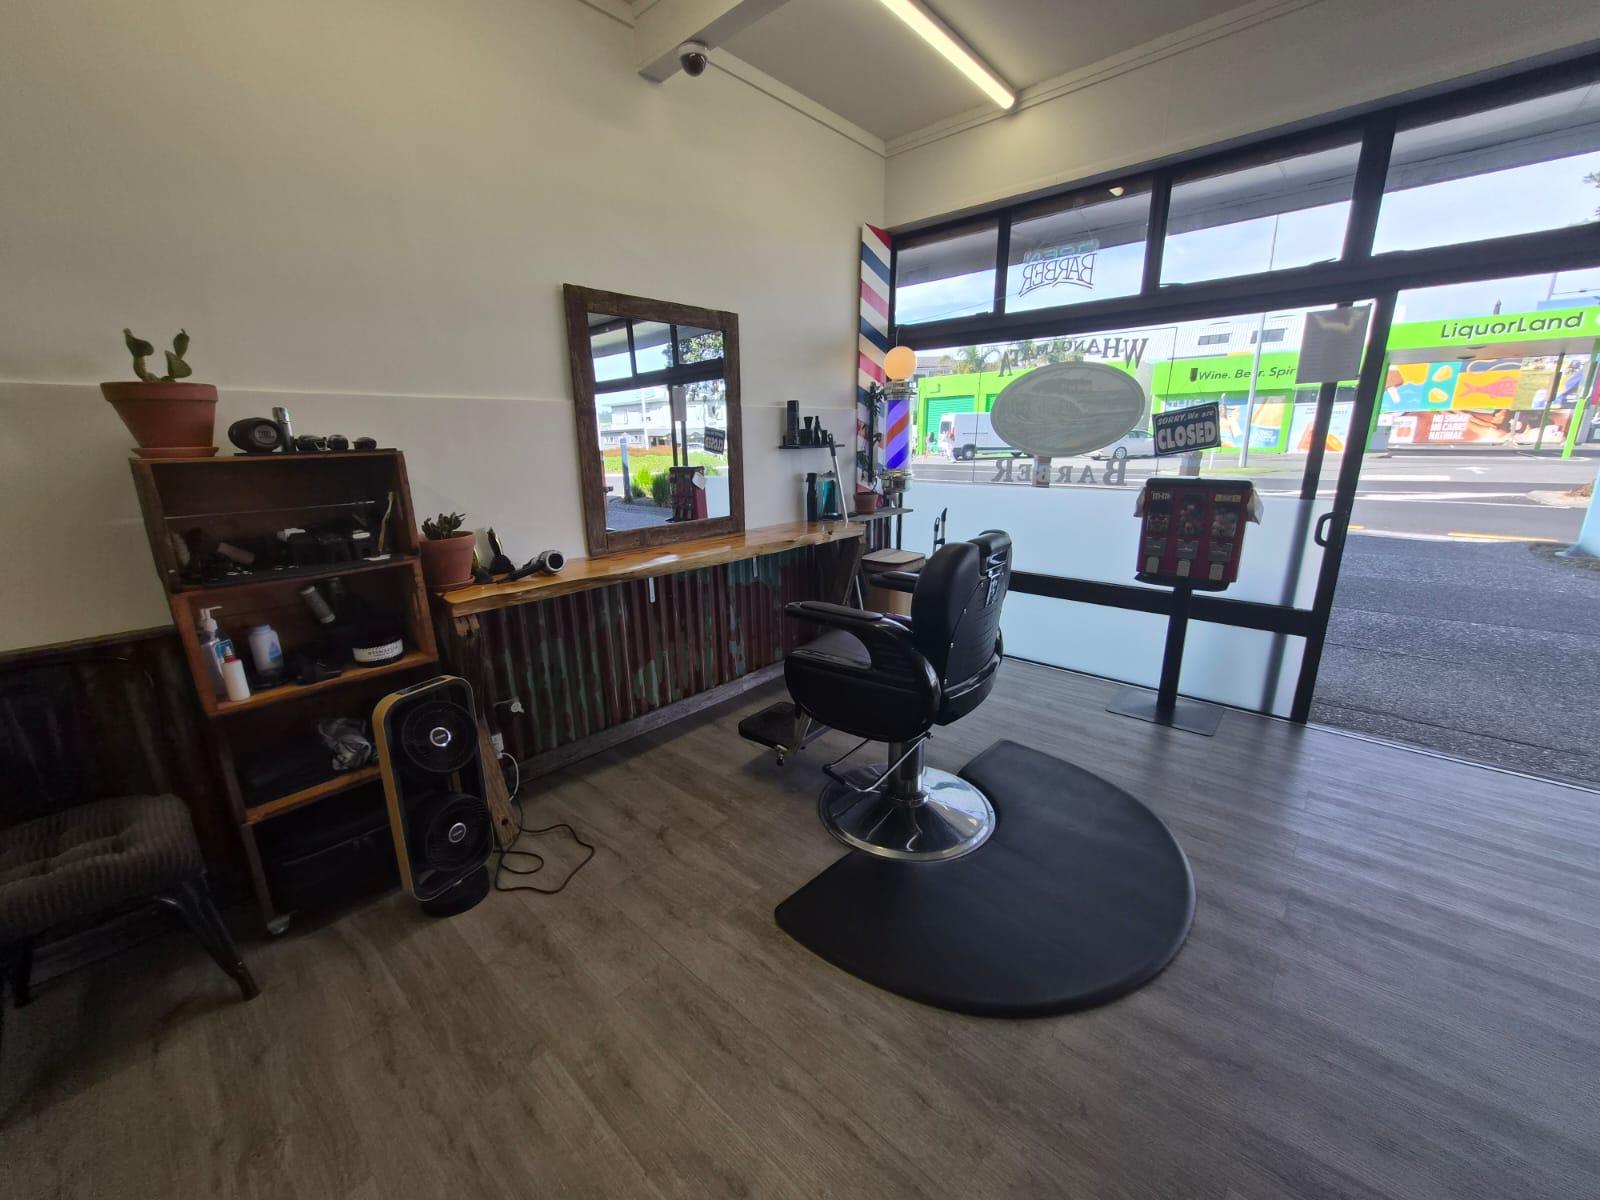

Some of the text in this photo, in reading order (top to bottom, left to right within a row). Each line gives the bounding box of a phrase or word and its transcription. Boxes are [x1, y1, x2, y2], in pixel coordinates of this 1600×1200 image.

[1199, 366, 1296, 380] Wine. Ber. Spir
[1157, 421, 1216, 450] CLOSED
